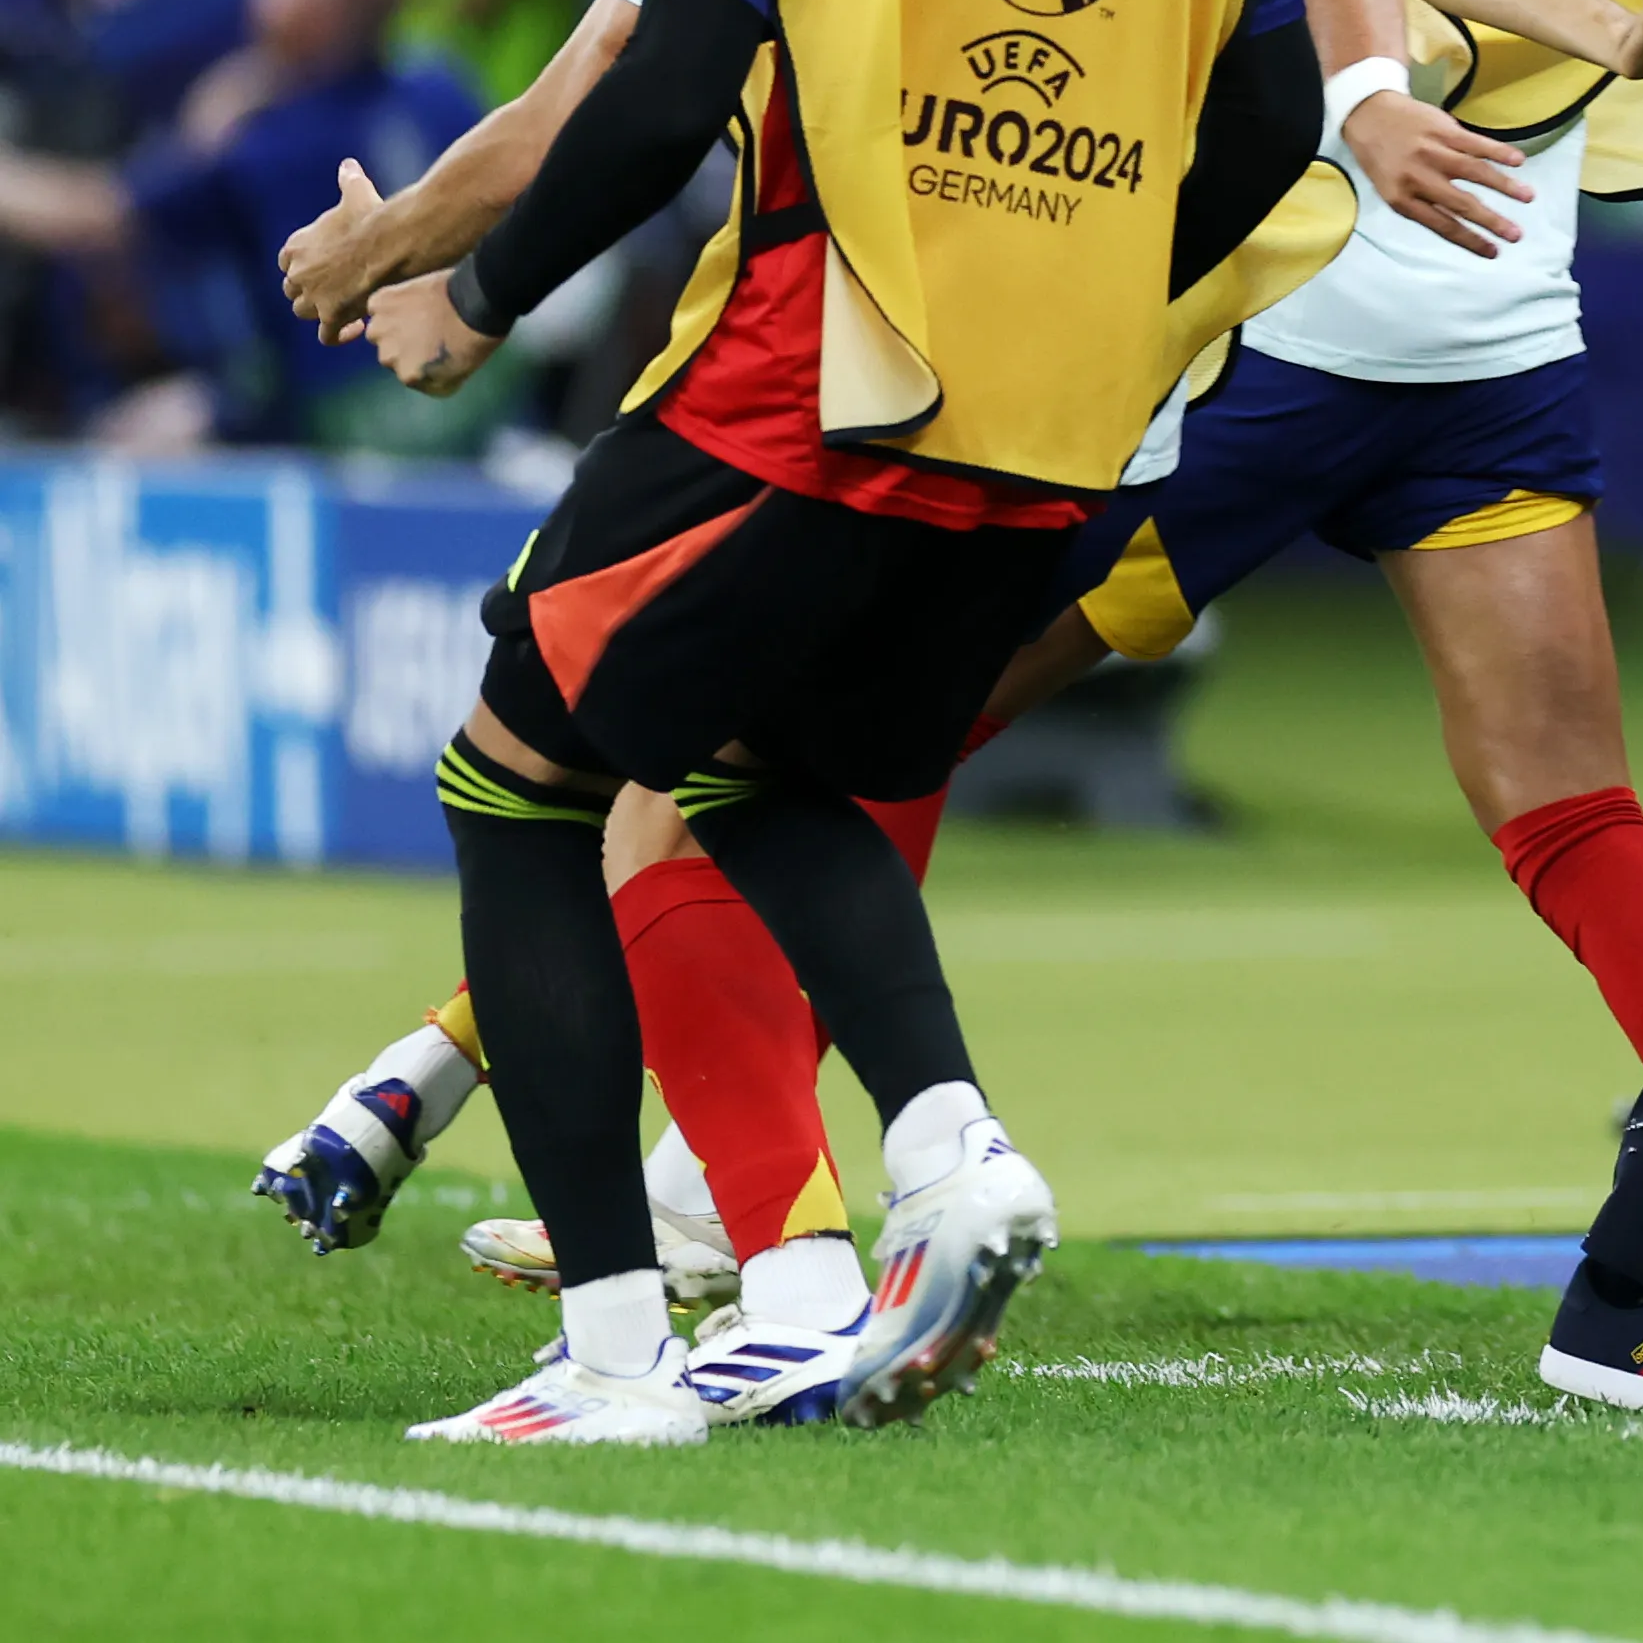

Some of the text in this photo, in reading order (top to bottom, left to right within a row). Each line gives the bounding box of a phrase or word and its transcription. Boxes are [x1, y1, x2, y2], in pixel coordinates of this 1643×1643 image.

[967, 41, 1071, 100] UEFA
[900, 88, 1144, 194] URO2024
[908, 164, 1082, 226] GERMANY
